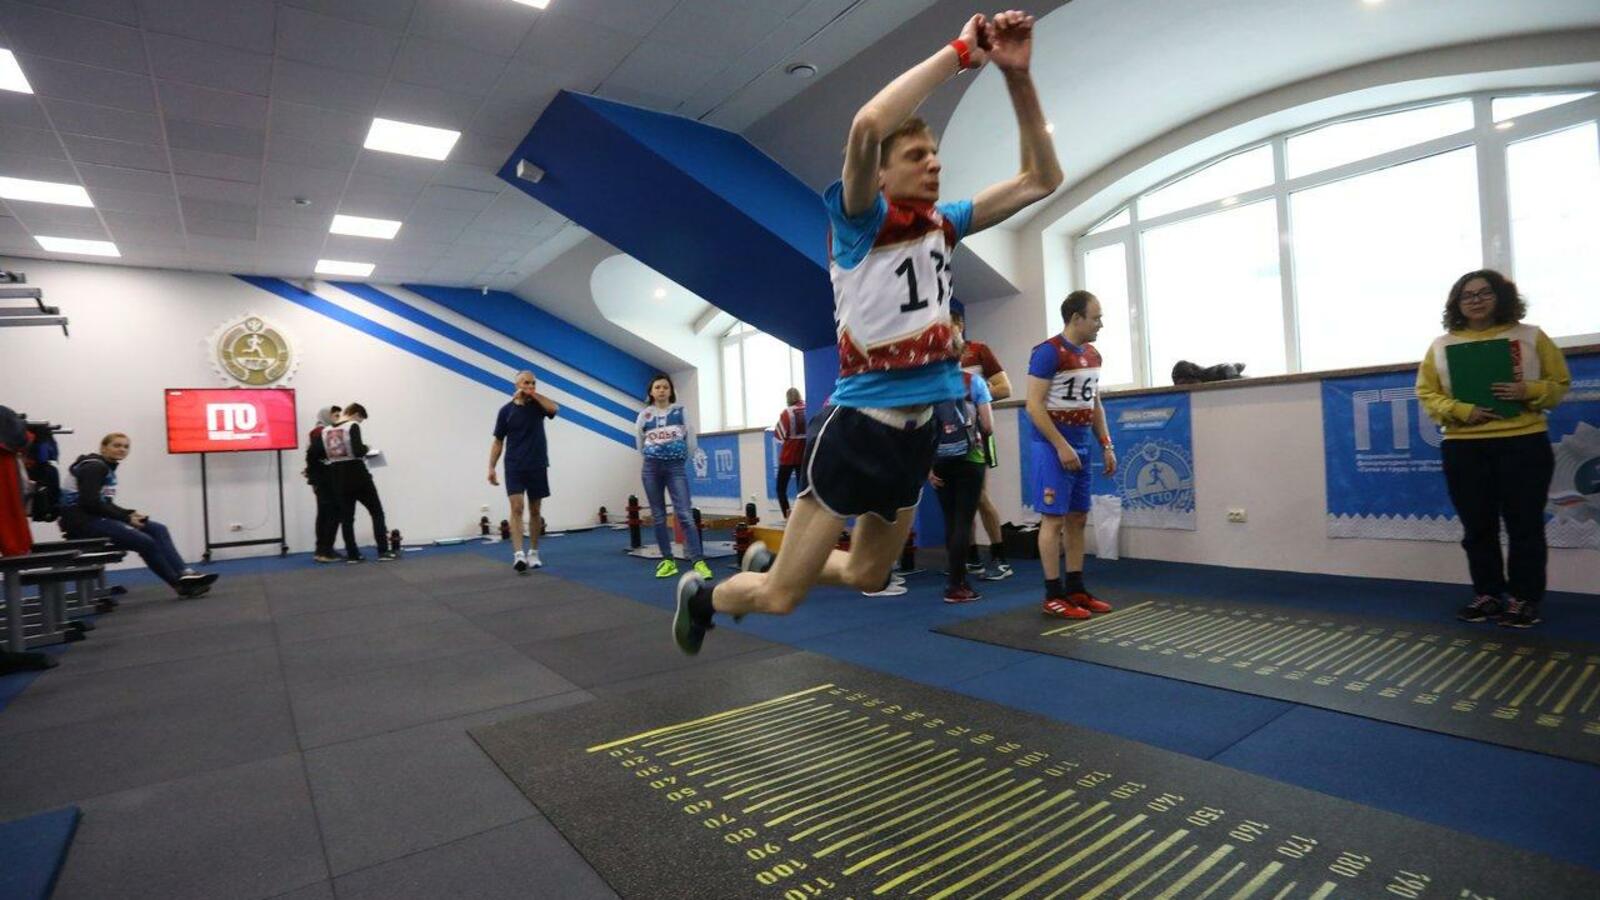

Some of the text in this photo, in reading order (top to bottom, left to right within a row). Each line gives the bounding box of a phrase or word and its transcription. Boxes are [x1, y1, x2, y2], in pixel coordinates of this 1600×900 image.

[206, 403, 257, 431] ГТО
[1014, 751, 1049, 767] 100
[1045, 761, 1079, 777] 110
[650, 776, 676, 789] 40
[1076, 771, 1112, 788] 120
[667, 787, 697, 801] 50
[1110, 781, 1147, 799] 130
[684, 800, 712, 814] 60
[1147, 793, 1184, 812] 140
[703, 813, 737, 829] 70
[1186, 806, 1225, 827] 150
[724, 828, 757, 844] 80
[1229, 819, 1270, 842] 160
[746, 843, 781, 860] 90
[1276, 834, 1319, 859] 170
[756, 859, 808, 885] 100
[1328, 851, 1372, 878] 180
[1386, 869, 1431, 899] 190
